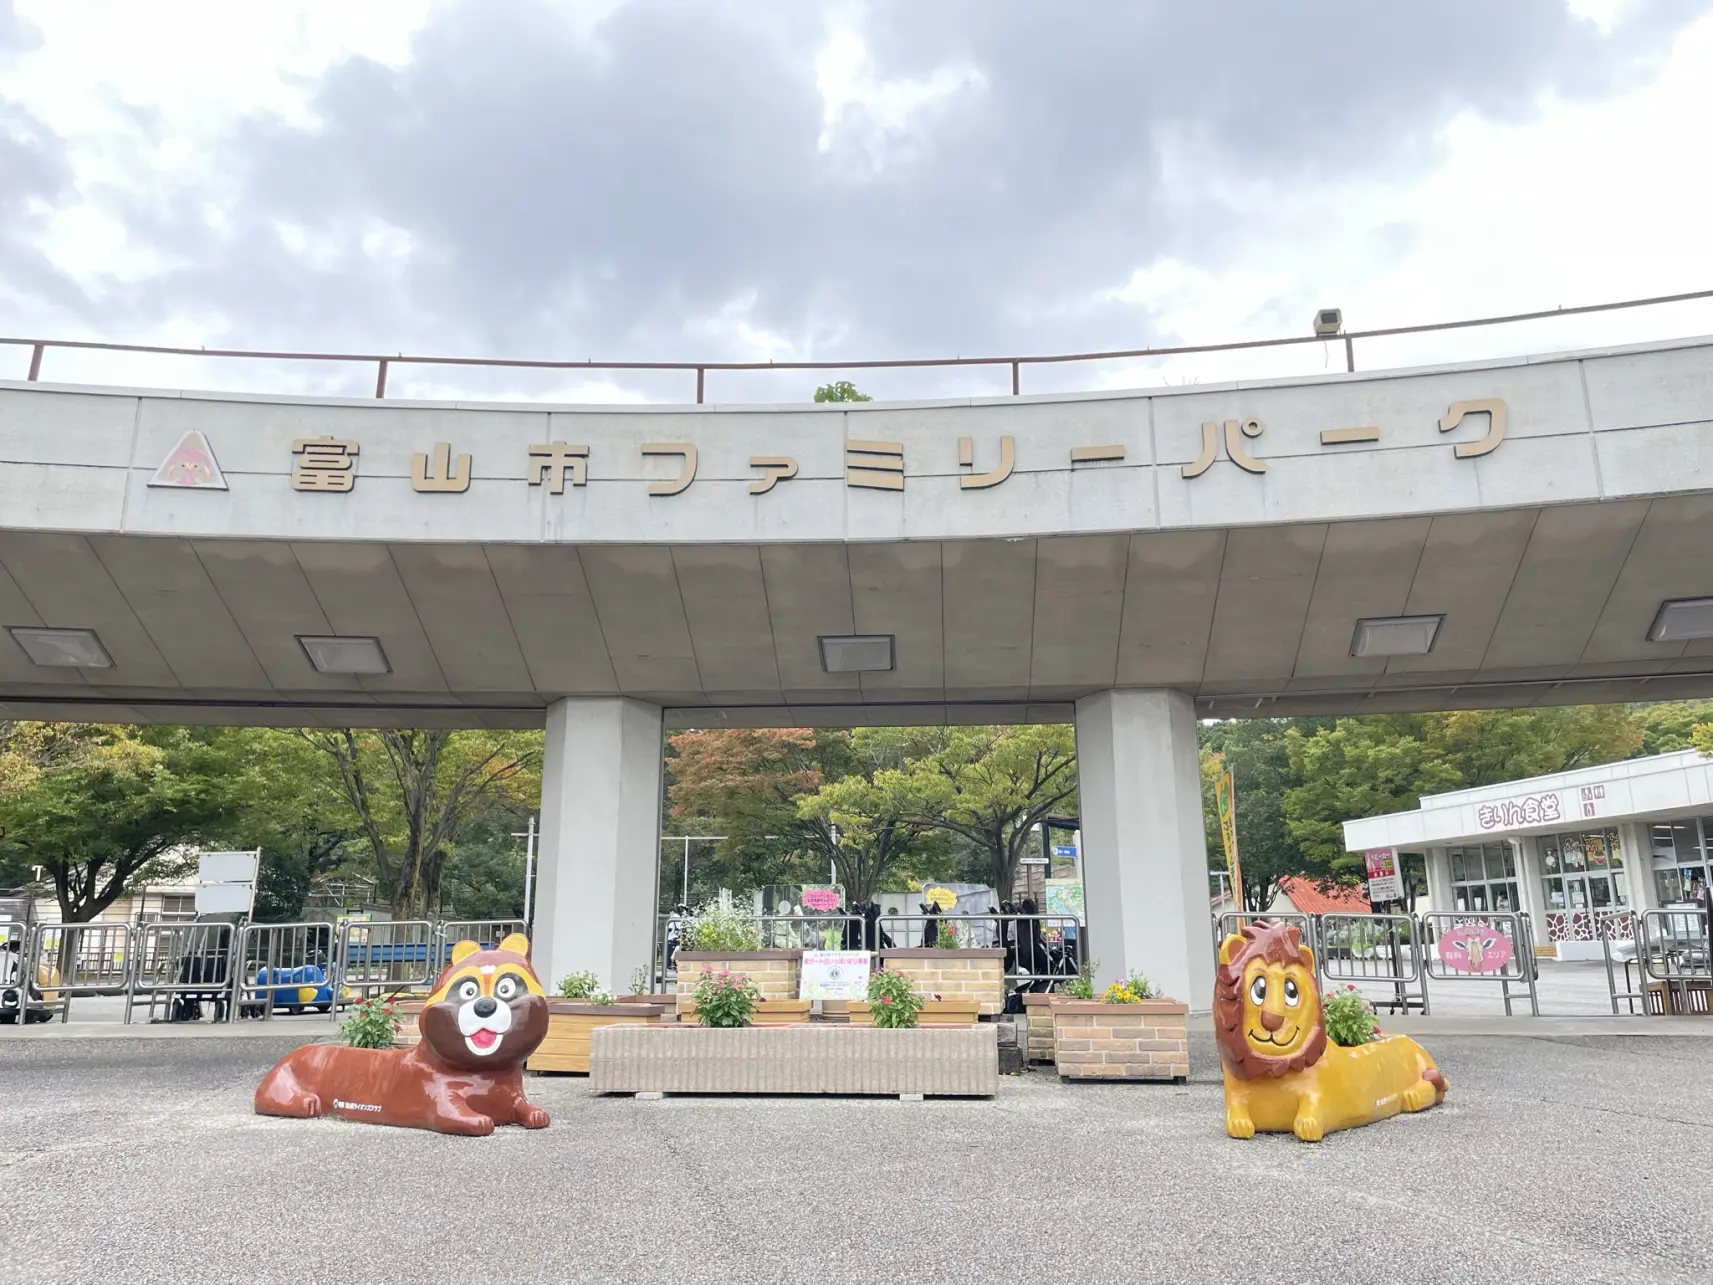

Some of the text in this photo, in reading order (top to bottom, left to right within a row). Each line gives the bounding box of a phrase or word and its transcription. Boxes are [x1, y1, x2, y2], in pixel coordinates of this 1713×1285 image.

[291, 397, 1508, 496] 富山市ファミリーパーク
[1478, 794, 1560, 829] きりん食堂
[1487, 950, 1507, 959] エリア
